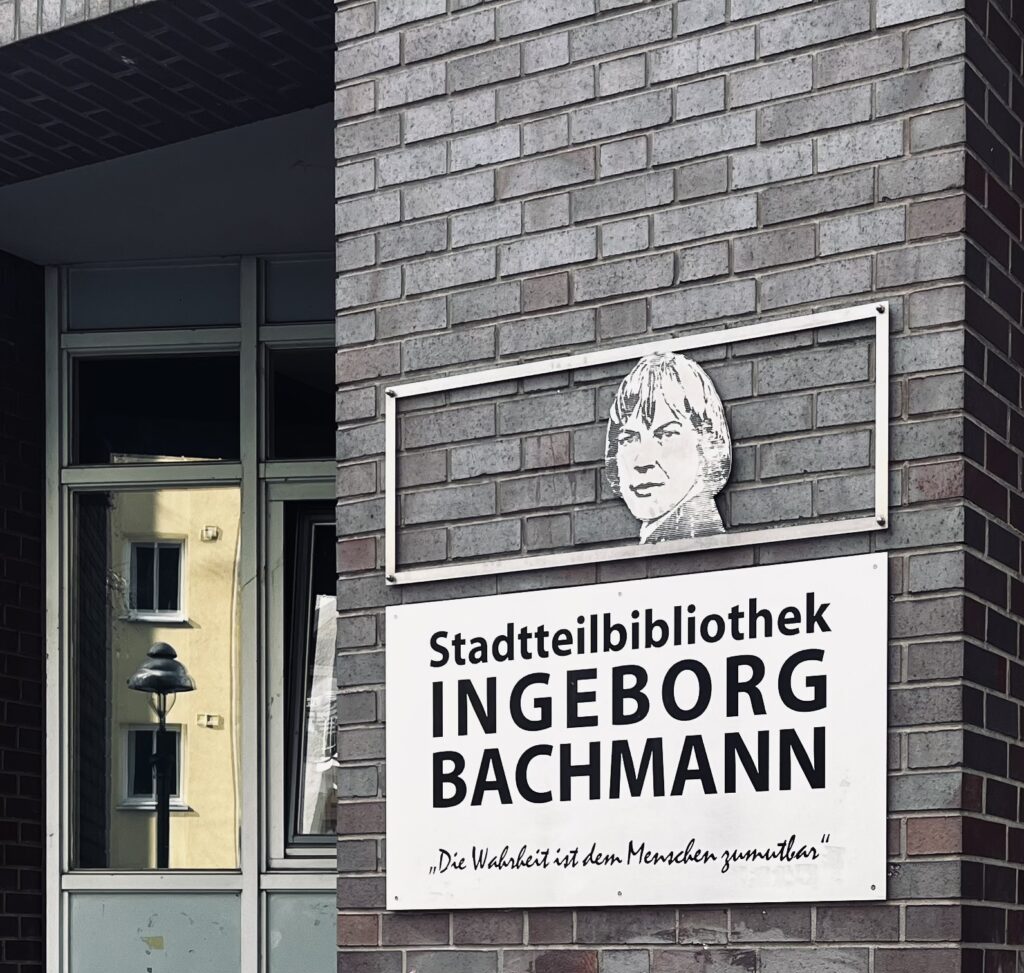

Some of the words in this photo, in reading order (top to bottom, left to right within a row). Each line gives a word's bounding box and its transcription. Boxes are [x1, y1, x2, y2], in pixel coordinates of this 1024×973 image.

[430, 592, 832, 668] Stadtteilbibliothek
[432, 648, 829, 738] INGEBORG
[432, 725, 827, 809] BACHMANN
[472, 844, 550, 871] Wahrheit
[553, 847, 579, 869] ist
[582, 842, 623, 867] dem
[626, 838, 718, 866] Menschen
